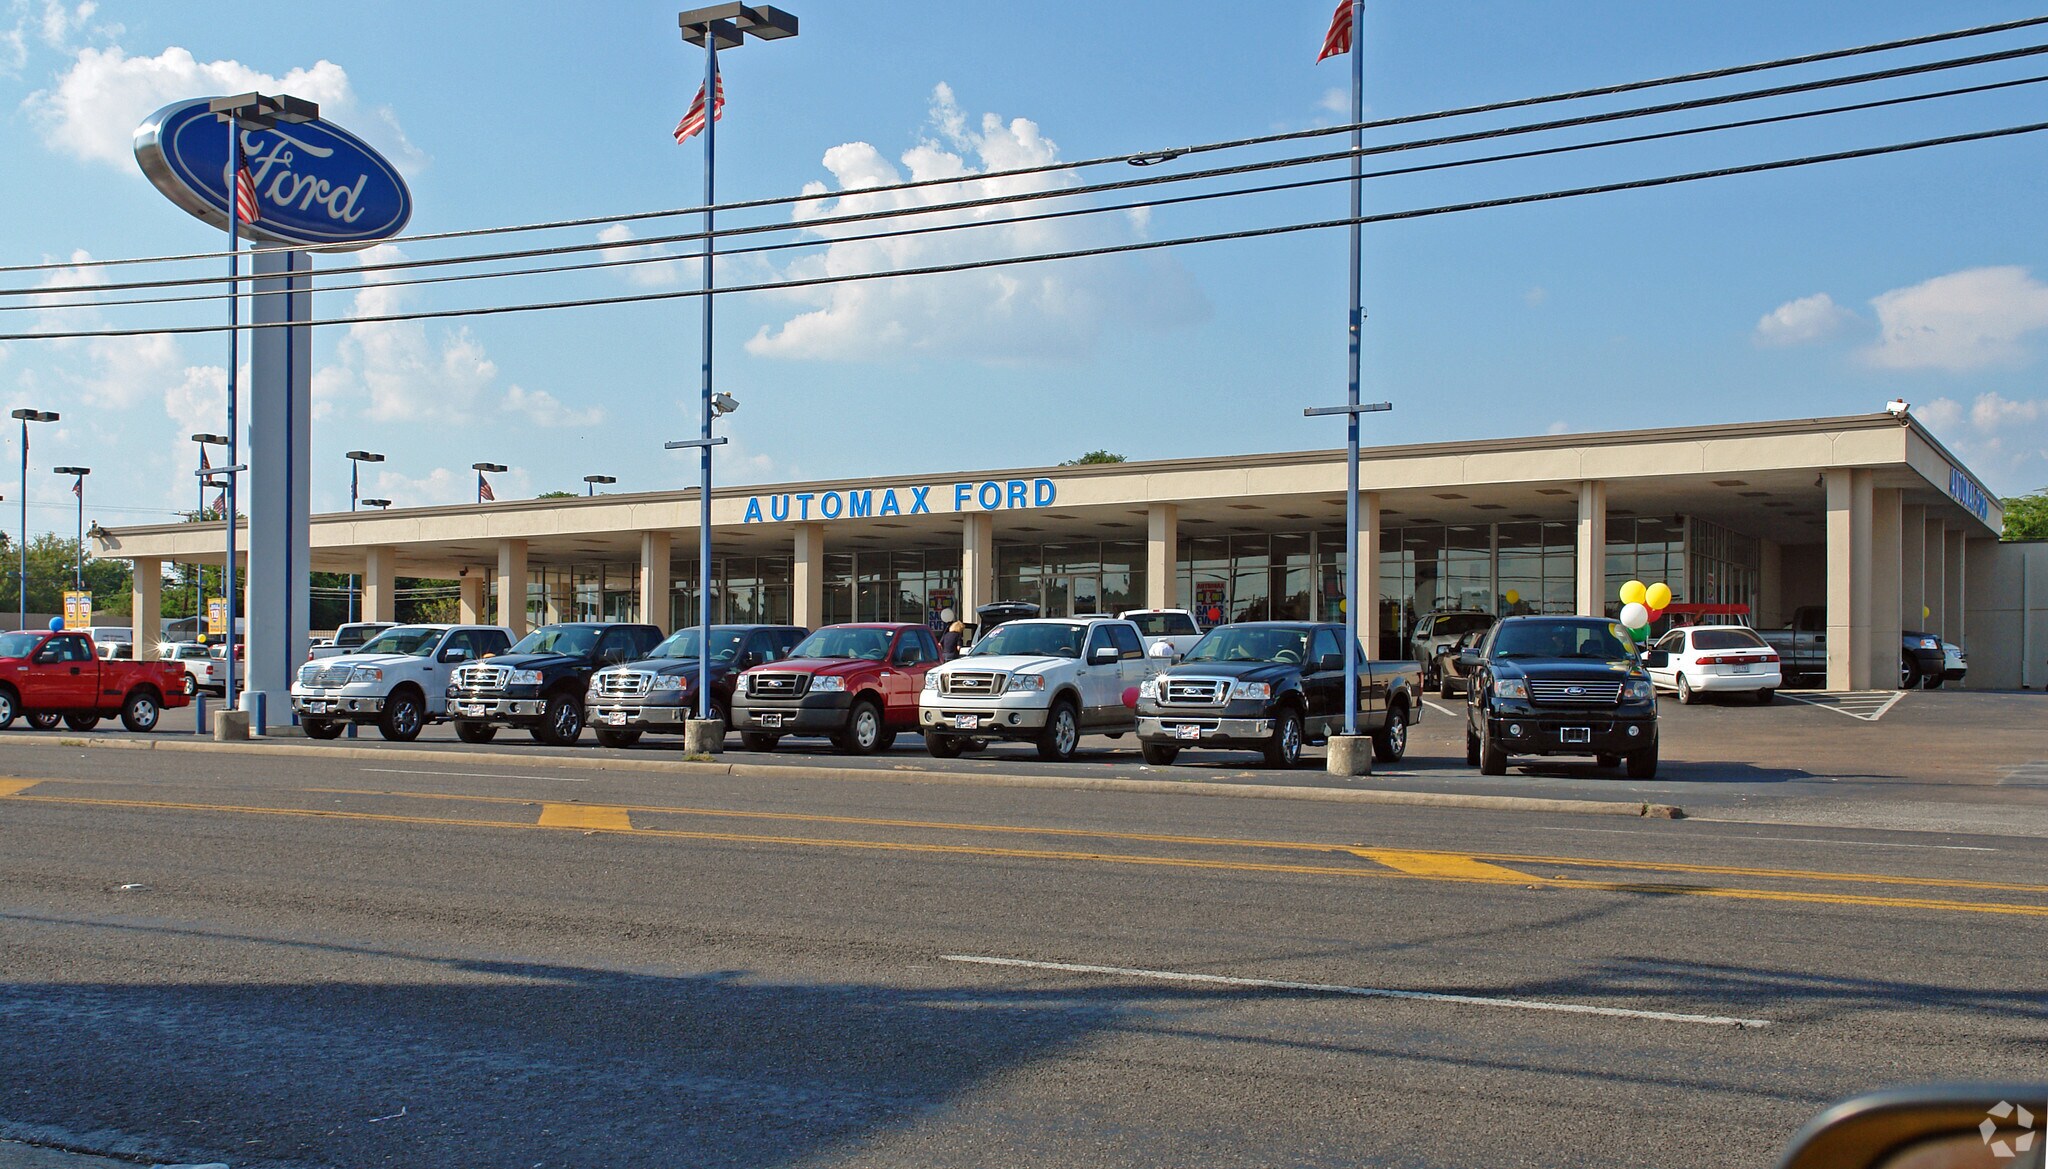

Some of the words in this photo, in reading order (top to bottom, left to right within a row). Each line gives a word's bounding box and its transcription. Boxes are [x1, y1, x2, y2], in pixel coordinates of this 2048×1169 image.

[223, 128, 368, 223] Ford
[743, 485, 931, 523] AUTOMAX
[954, 477, 1056, 511] FORD
[1196, 605, 1224, 616] SAS
